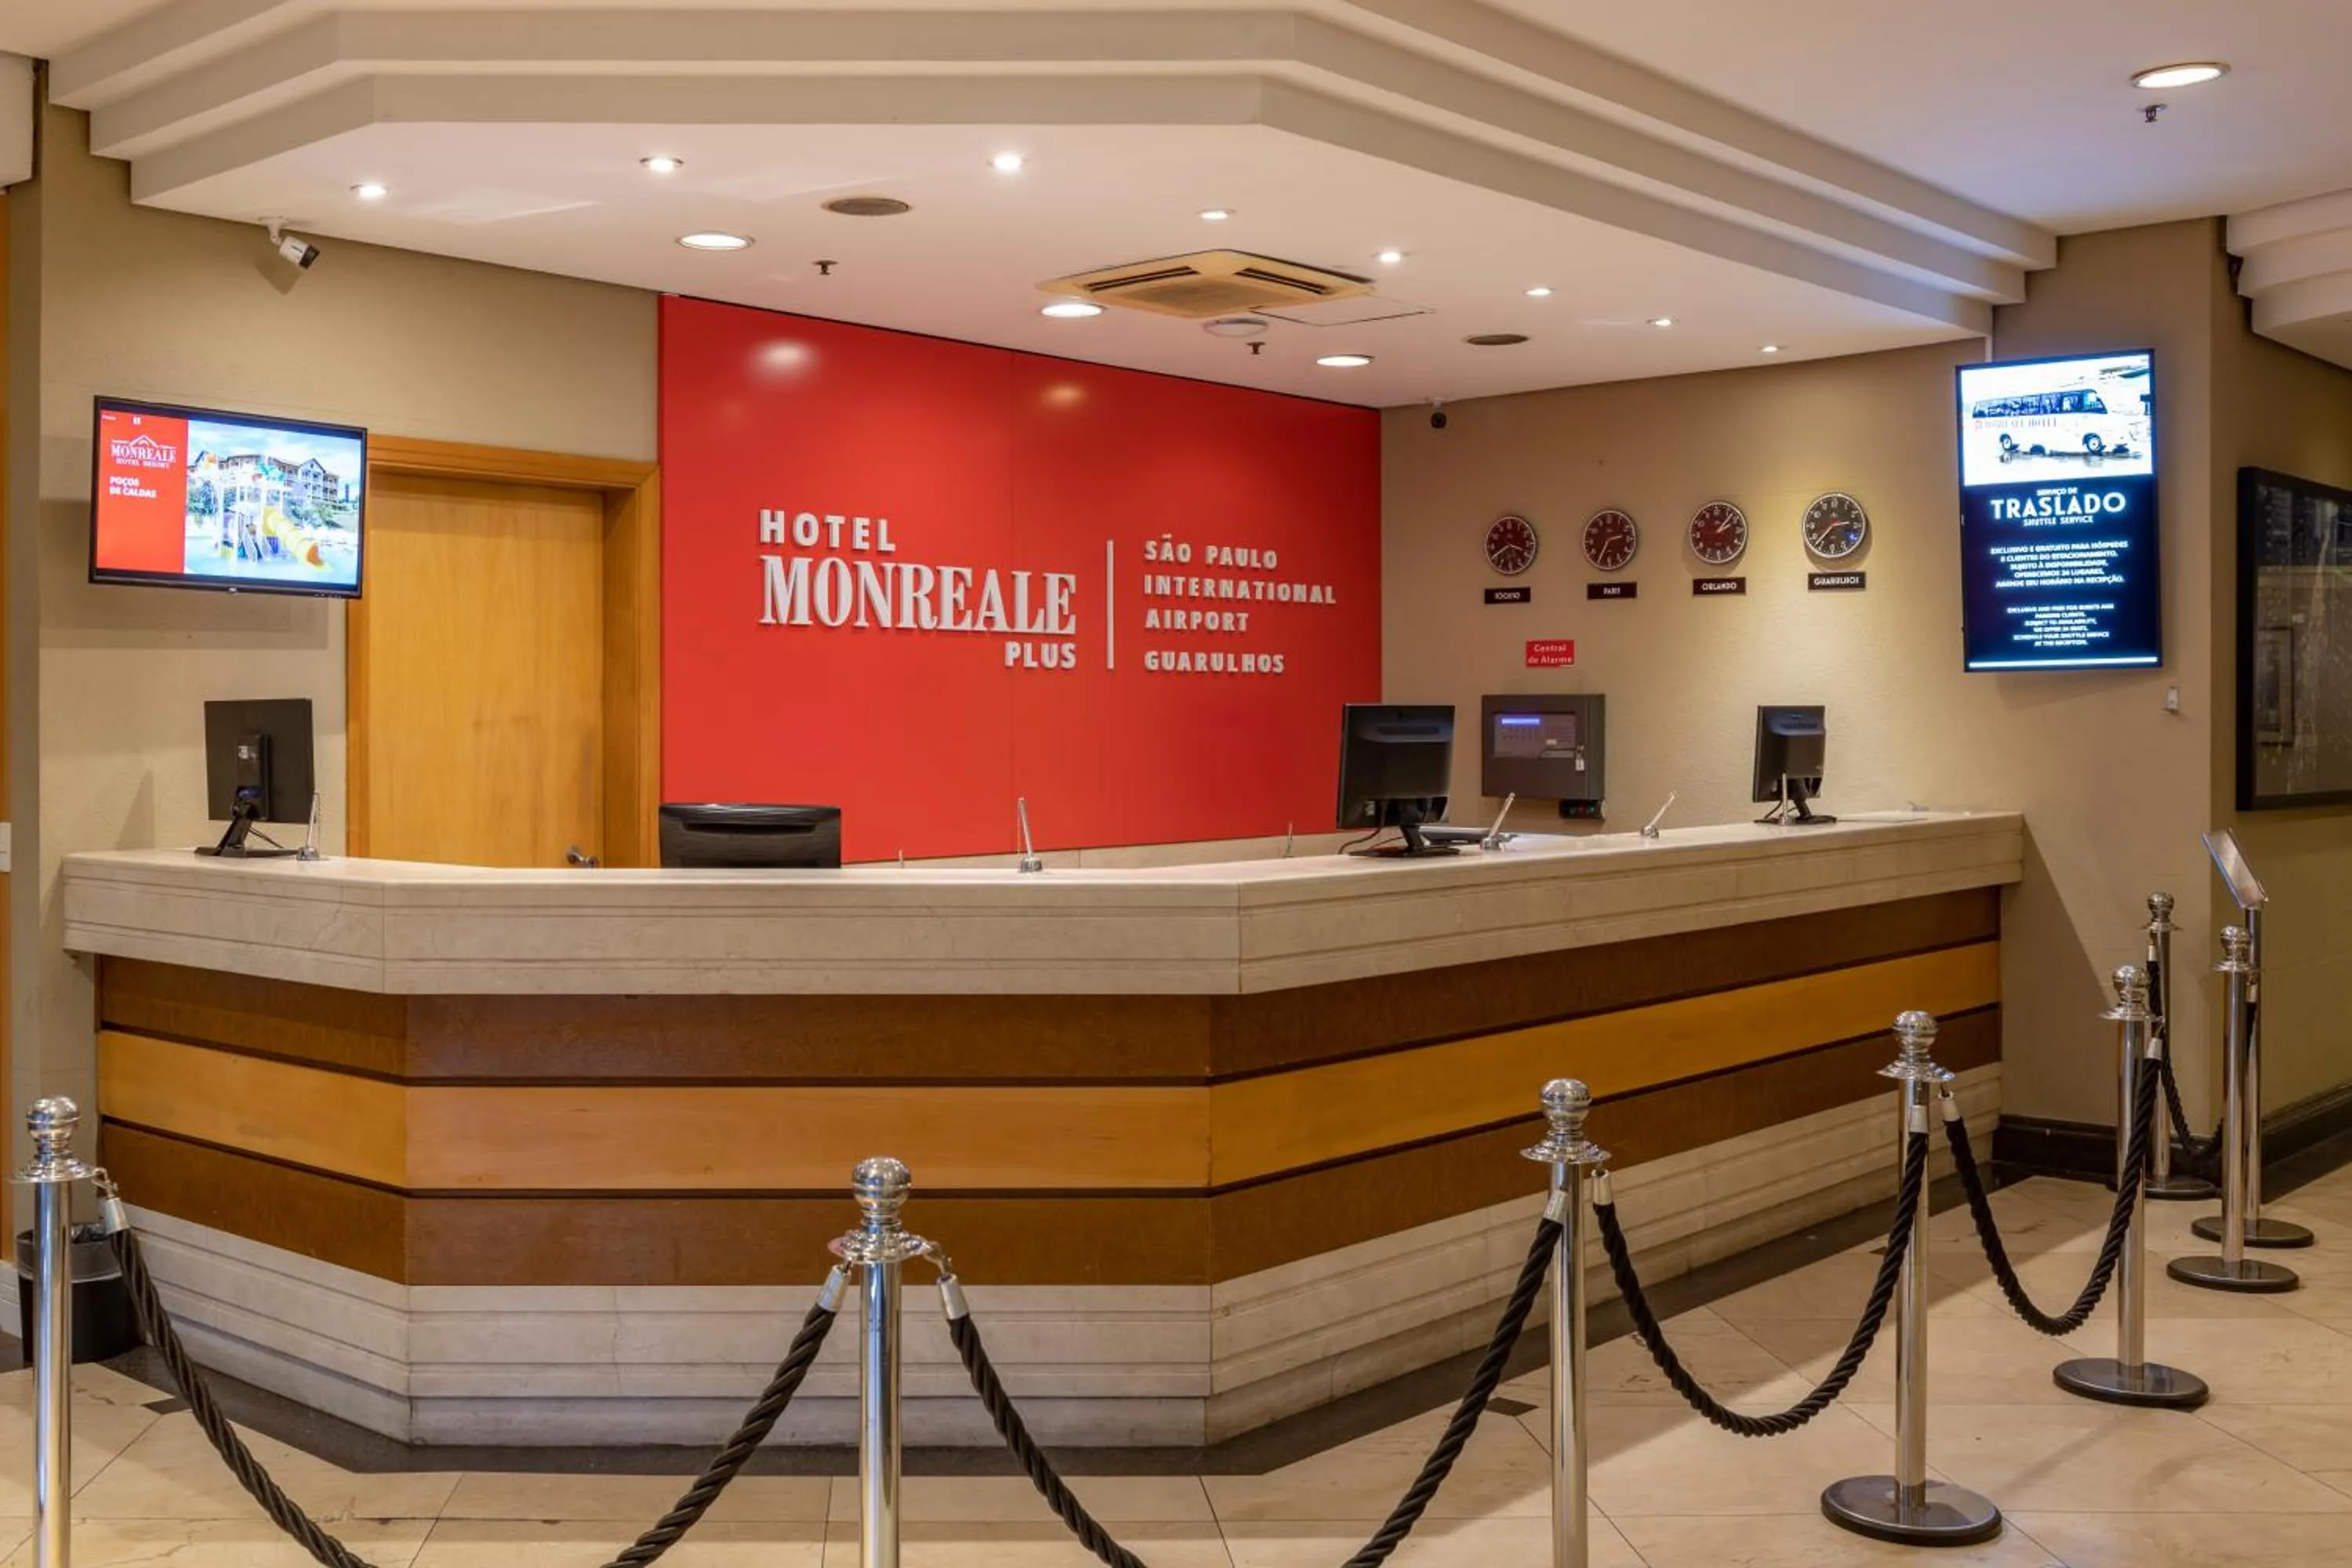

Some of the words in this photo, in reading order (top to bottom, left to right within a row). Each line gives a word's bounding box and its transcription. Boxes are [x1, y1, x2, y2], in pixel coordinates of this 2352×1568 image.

[111, 444, 176, 463] MONREALE
[1990, 492, 2127, 519] TRASLADO
[760, 509, 896, 551] HOTEL
[1145, 533, 1191, 563] SÃO
[1205, 546, 1277, 569] PAULO
[759, 554, 1076, 634] MONREALE
[1144, 574, 1337, 604] INTERNATIONAL
[1701, 582, 1737, 590] ORLANDO
[1145, 608, 1249, 631] AIRPORT
[1004, 641, 1076, 668] PLUS
[1144, 650, 1284, 673] GUARULHOS
[1534, 644, 1566, 652] Central
